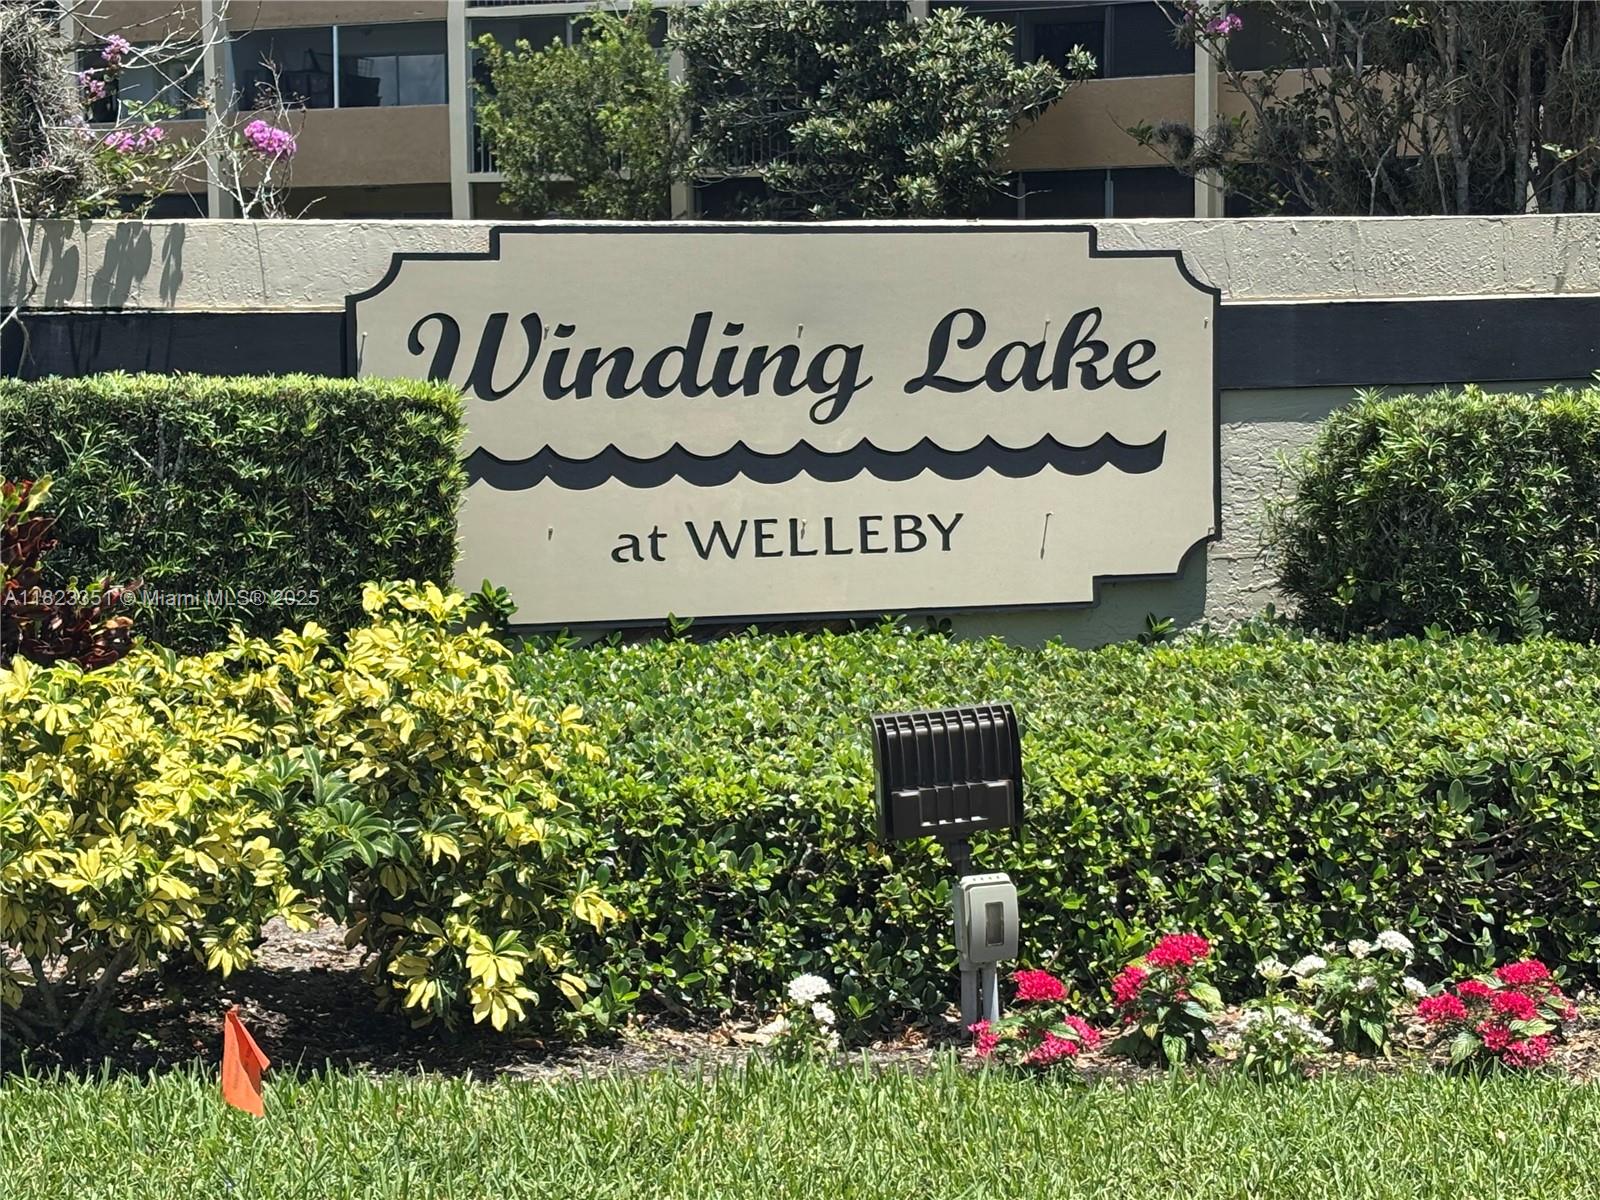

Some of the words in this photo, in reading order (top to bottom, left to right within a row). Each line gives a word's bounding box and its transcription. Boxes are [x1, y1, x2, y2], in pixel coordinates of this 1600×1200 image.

[407, 310, 873, 425] Winding
[904, 307, 1161, 394] Lake
[611, 525, 668, 563] at
[685, 513, 964, 561] WELLEBY
